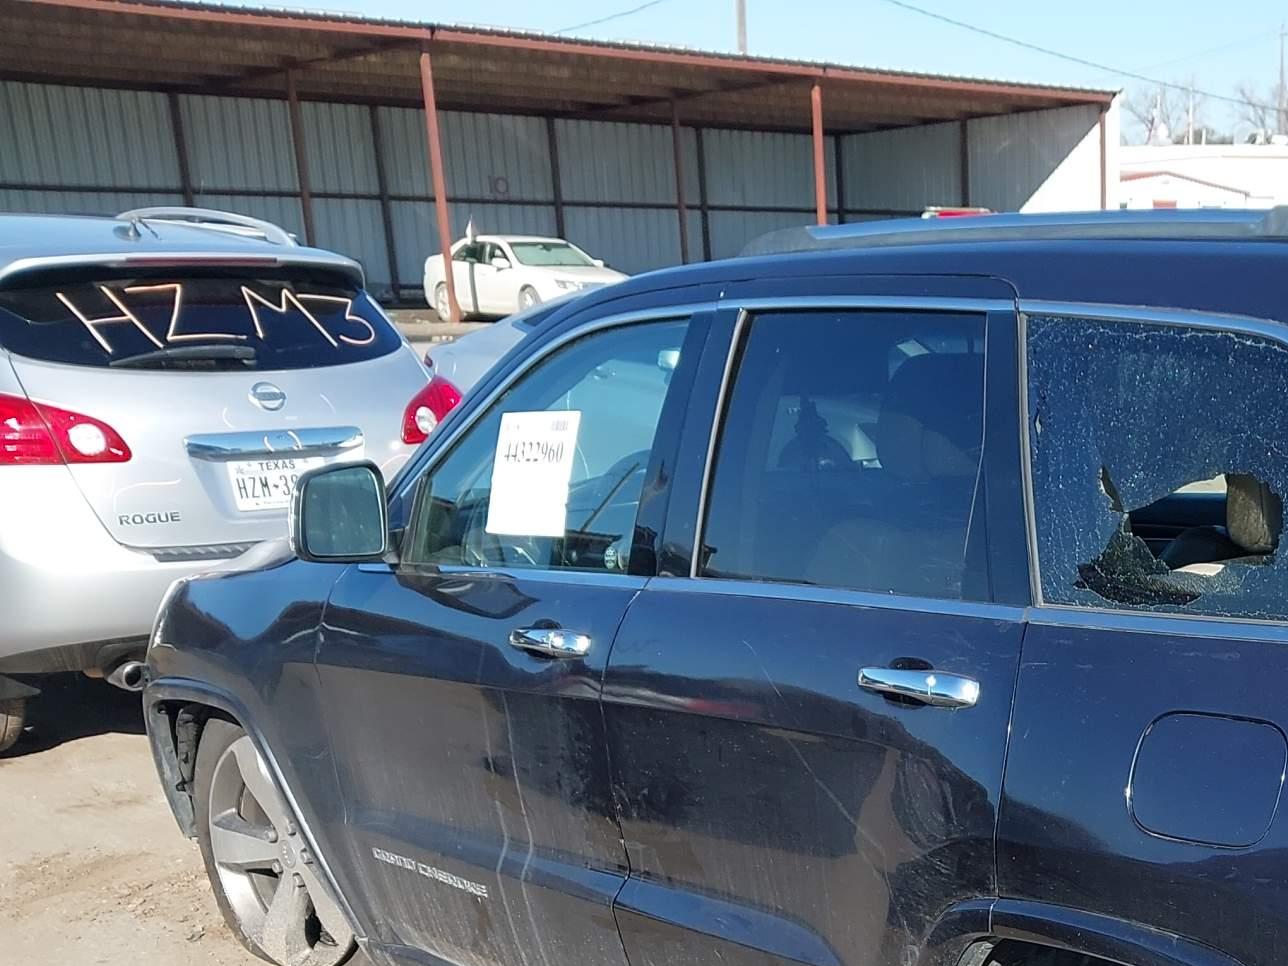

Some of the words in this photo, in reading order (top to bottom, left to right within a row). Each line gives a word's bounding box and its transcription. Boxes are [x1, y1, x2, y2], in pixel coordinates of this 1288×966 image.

[503, 441, 564, 462] 44322960
[258, 460, 296, 472] TEXAS
[118, 511, 181, 525] ROGUE
